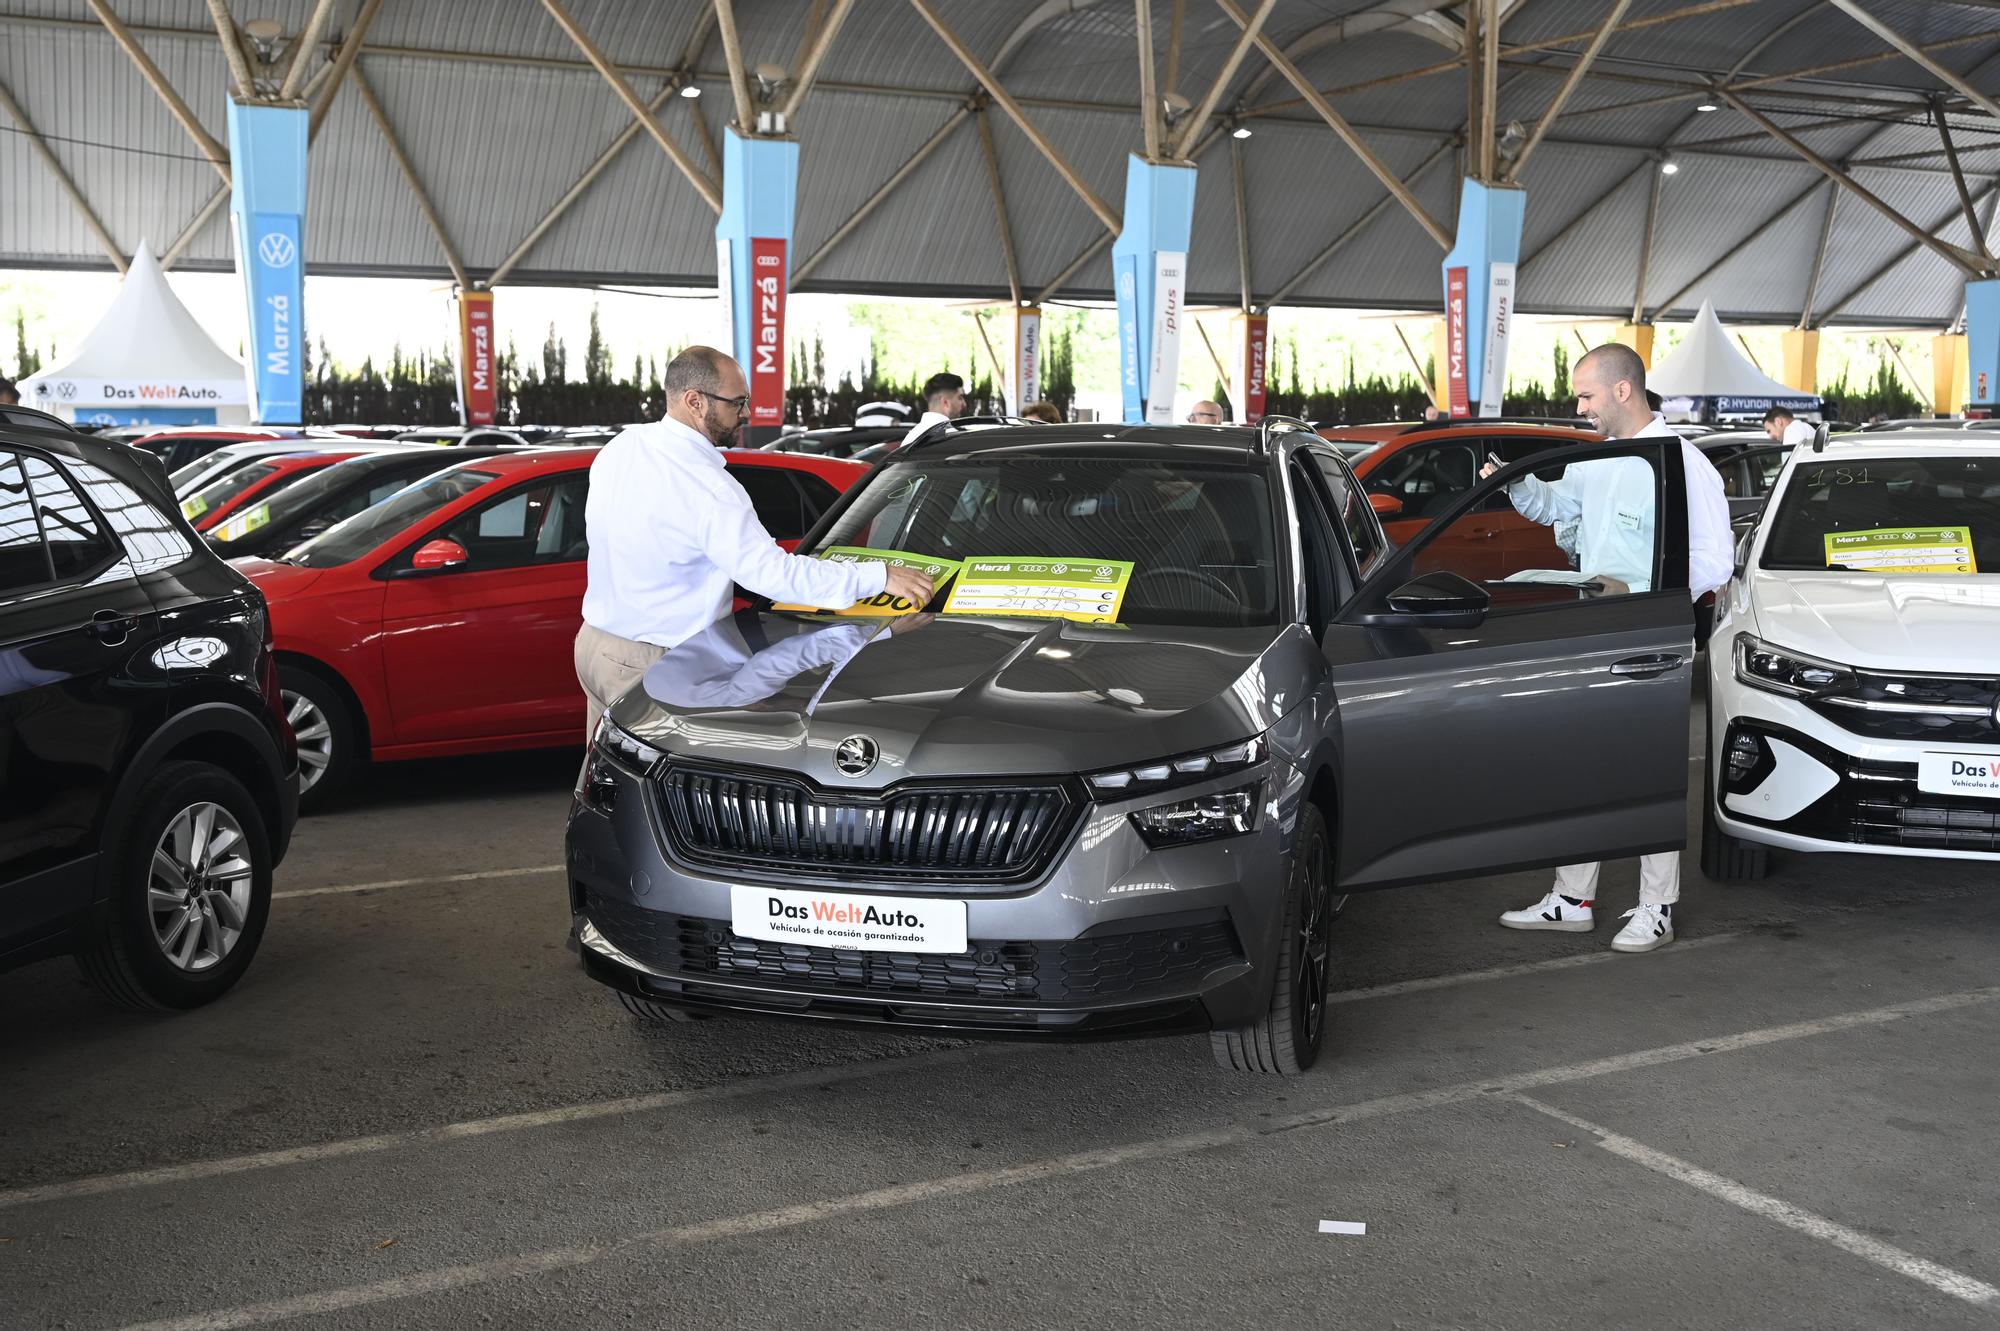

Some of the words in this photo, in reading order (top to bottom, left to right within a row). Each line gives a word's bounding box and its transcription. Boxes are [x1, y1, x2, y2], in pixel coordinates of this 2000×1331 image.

[267, 295, 289, 375] Marzá
[756, 276, 778, 373] Marzá
[1451, 299, 1462, 378] Marzá
[471, 325, 489, 391] Marzá
[1124, 322, 1136, 386] Marzá
[1250, 341, 1264, 396] Marzá
[103, 385, 135, 399] Das
[1731, 399, 1772, 409] HYUNDAI
[1836, 535, 1868, 544] Marzá
[974, 563, 1011, 572] Marzá
[1951, 760, 1987, 777] Das
[1951, 779, 1987, 788] Vehículos
[768, 897, 809, 920] Das
[769, 922, 811, 934] Vehículos
[813, 926, 825, 936] de
[827, 928, 862, 939] ocasión
[864, 932, 925, 943] garantizados
